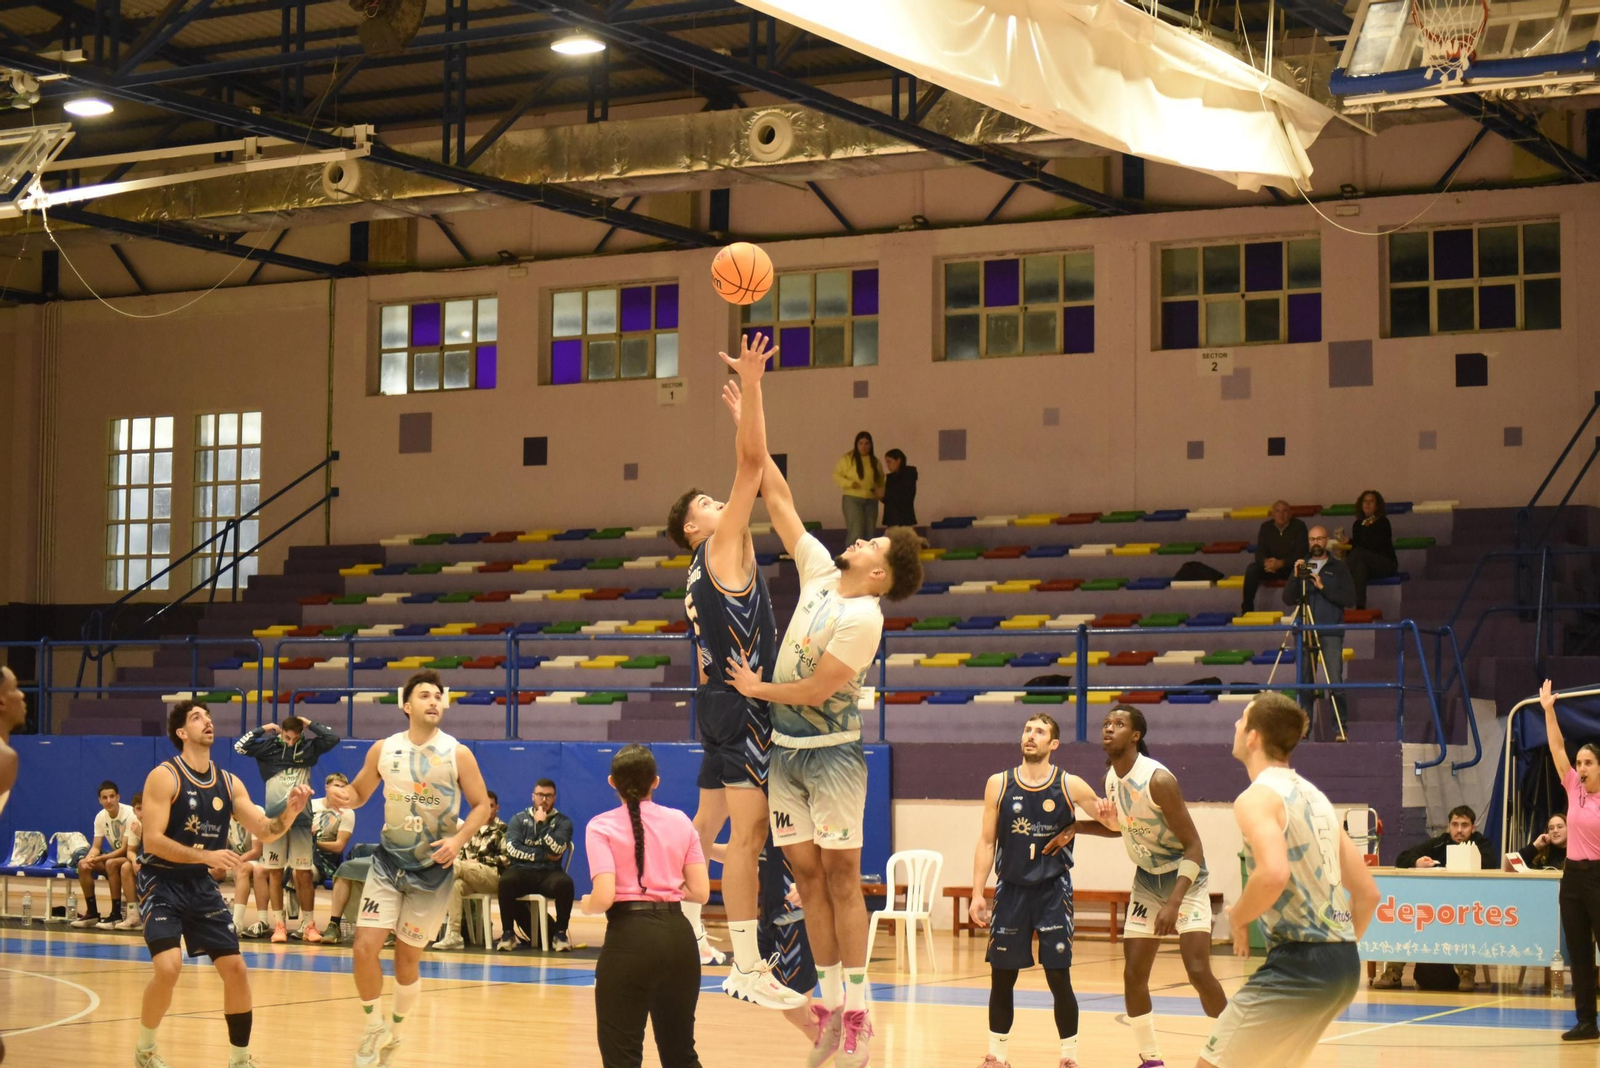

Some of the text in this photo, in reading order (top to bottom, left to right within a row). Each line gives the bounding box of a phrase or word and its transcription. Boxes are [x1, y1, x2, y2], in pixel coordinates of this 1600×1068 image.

[1211, 361, 1218, 372] 2
[670, 391, 674, 400] 1
[388, 792, 441, 806] surseeds
[403, 815, 424, 833] 28
[1029, 843, 1036, 860] 1
[1132, 843, 1152, 858] 93
[1376, 895, 1519, 932] deportes
